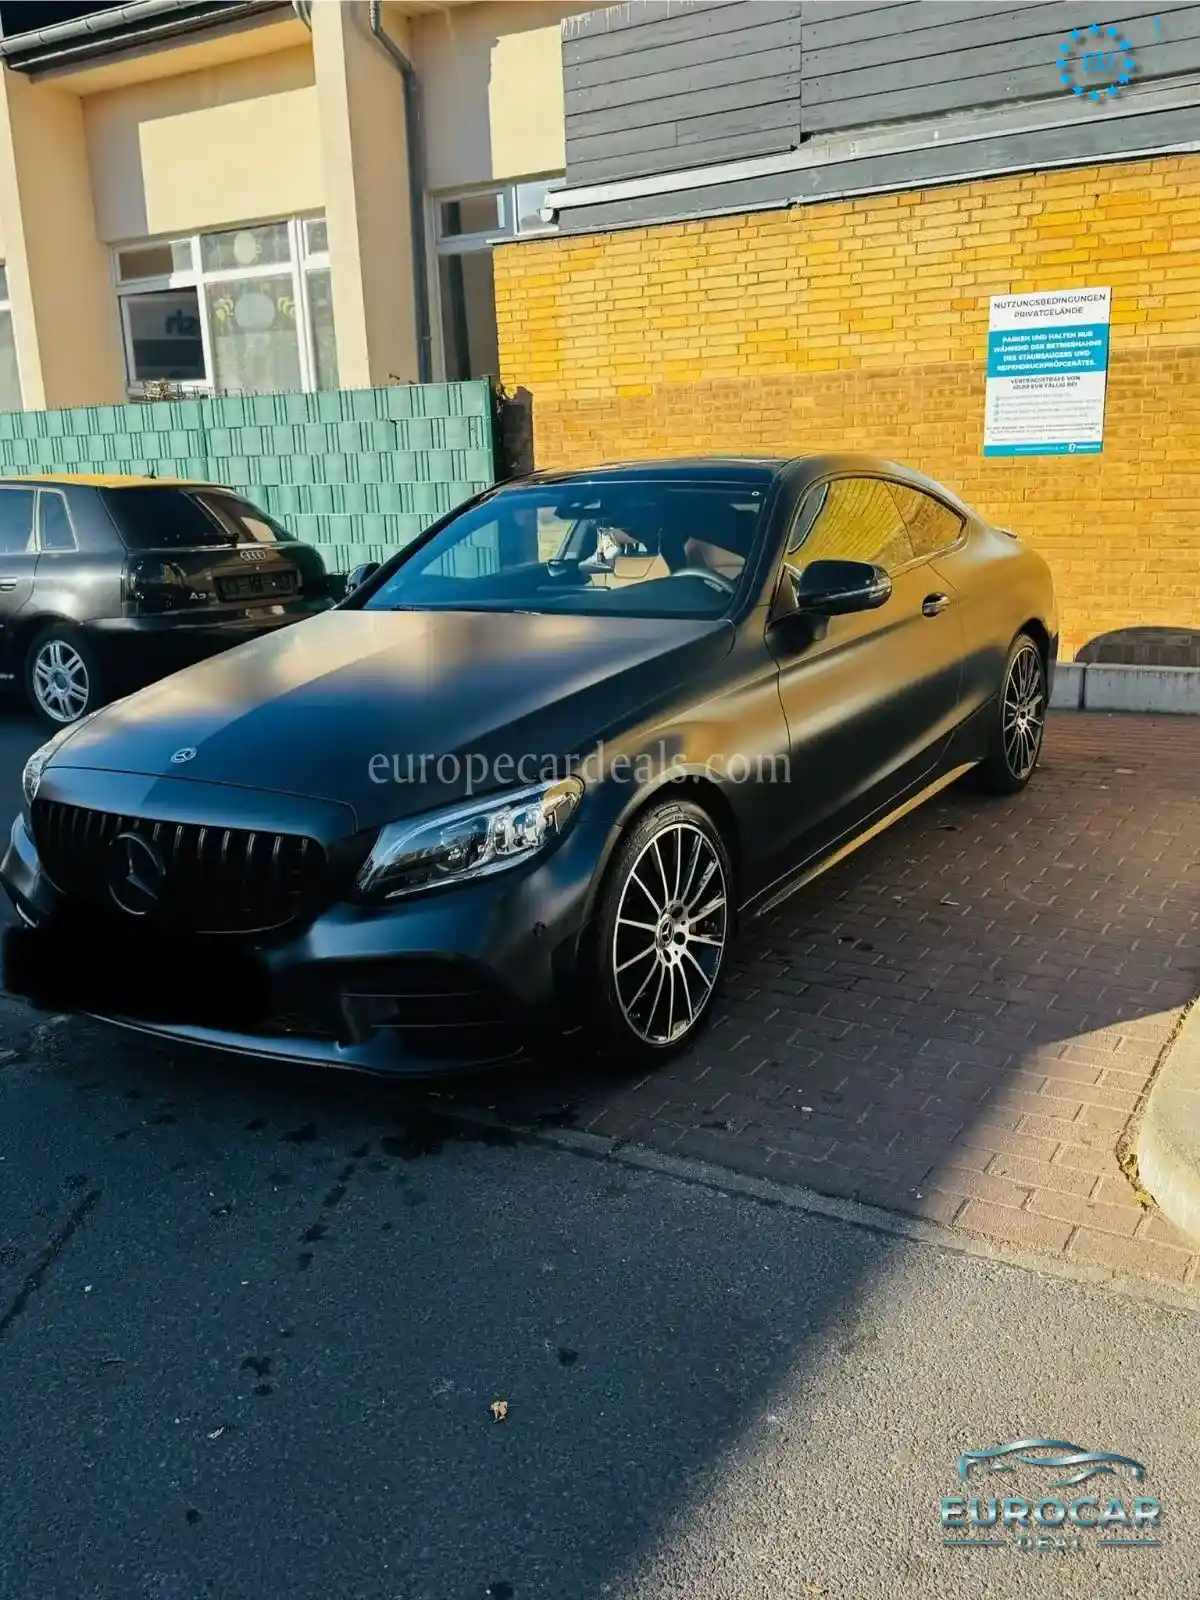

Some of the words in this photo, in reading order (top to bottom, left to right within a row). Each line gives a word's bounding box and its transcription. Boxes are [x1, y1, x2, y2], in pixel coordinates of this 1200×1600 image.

[994, 293, 1106, 309] NUTZUNGSBEDINGUNGEN
[1002, 335, 1030, 343] PARKEN
[1032, 333, 1047, 341] UND
[1049, 331, 1077, 340] HALTEN
